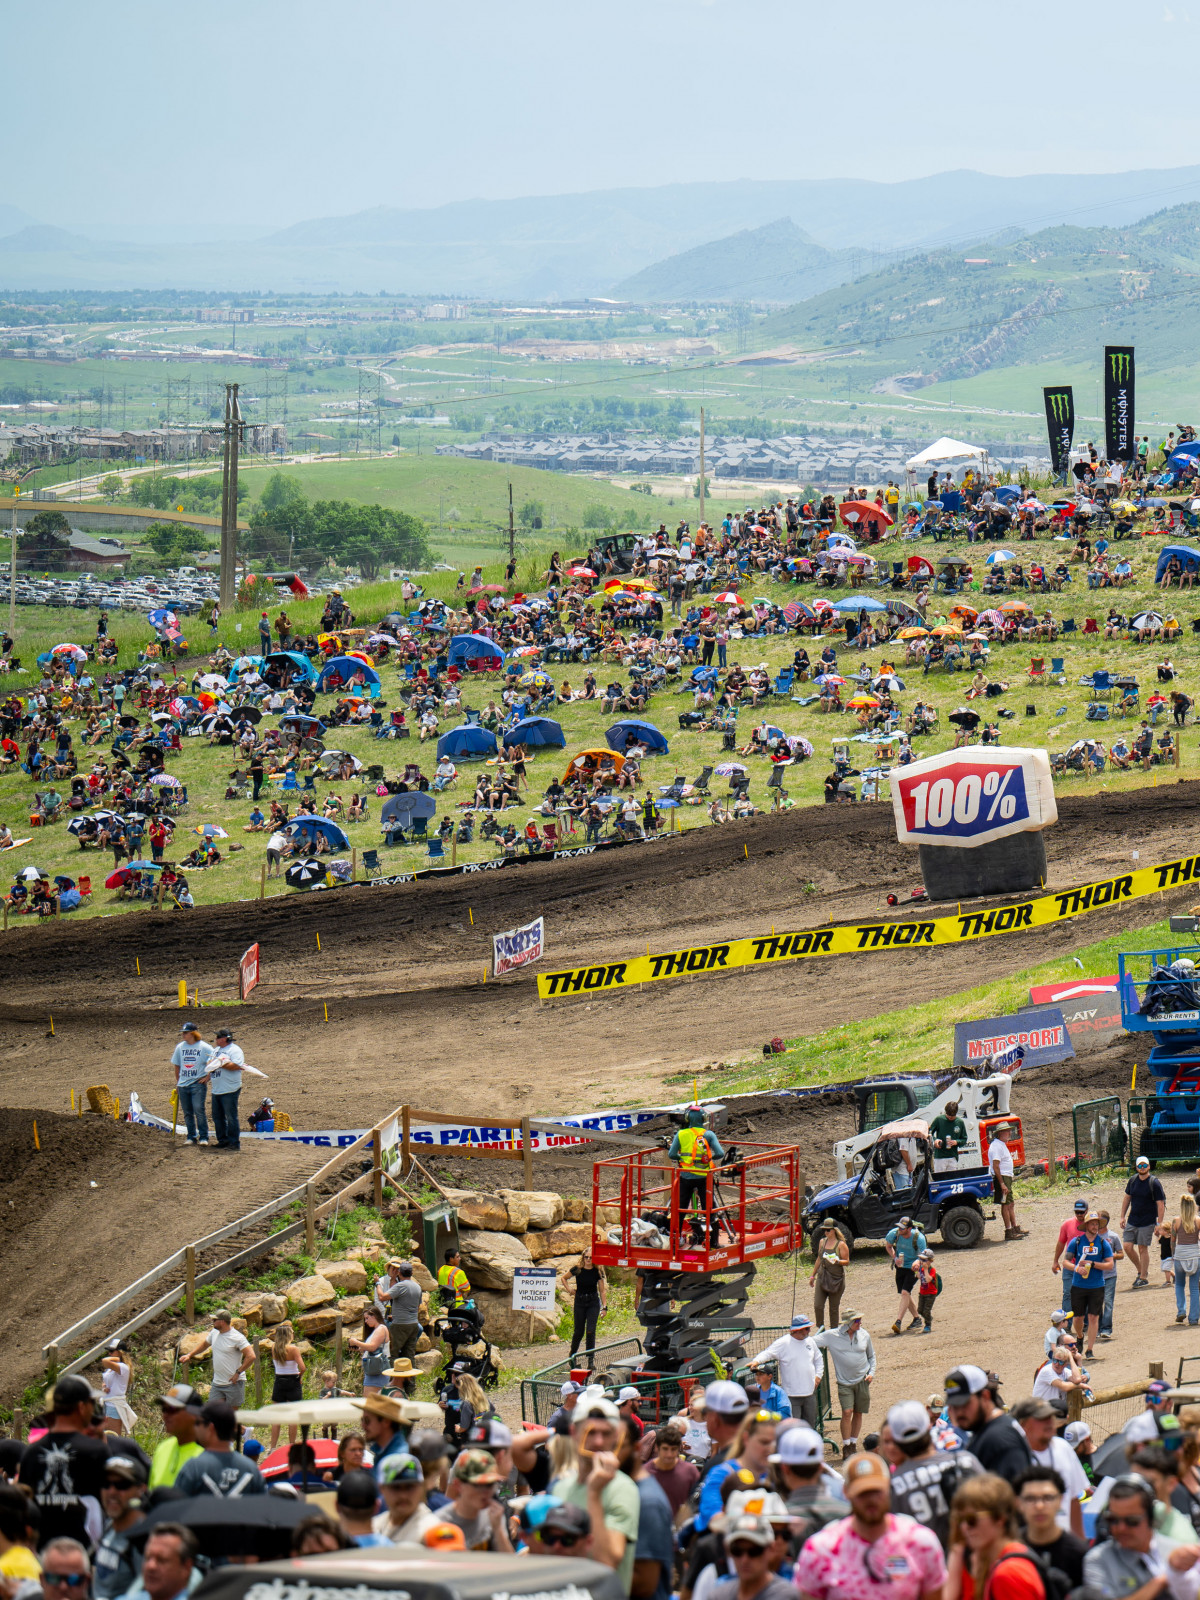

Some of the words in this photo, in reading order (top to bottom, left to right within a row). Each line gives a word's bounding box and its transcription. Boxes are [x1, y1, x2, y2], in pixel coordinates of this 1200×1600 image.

[1117, 389, 1129, 451] MONSTER
[910, 769, 1016, 828] 100%
[463, 860, 505, 873] MX-ATV
[554, 846, 596, 860] MX-ATV
[496, 922, 541, 959] PARTS
[546, 963, 627, 994] THOR
[649, 945, 730, 977] THOR
[752, 930, 834, 960] THOR
[856, 923, 935, 947] THOR
[958, 903, 1034, 937] THOR
[1055, 875, 1133, 916] THOR
[182, 1069, 198, 1077] CREW
[950, 1183, 964, 1194] 28
[708, 1250, 728, 1262] SKYJACK
[908, 1484, 949, 1523] 97
